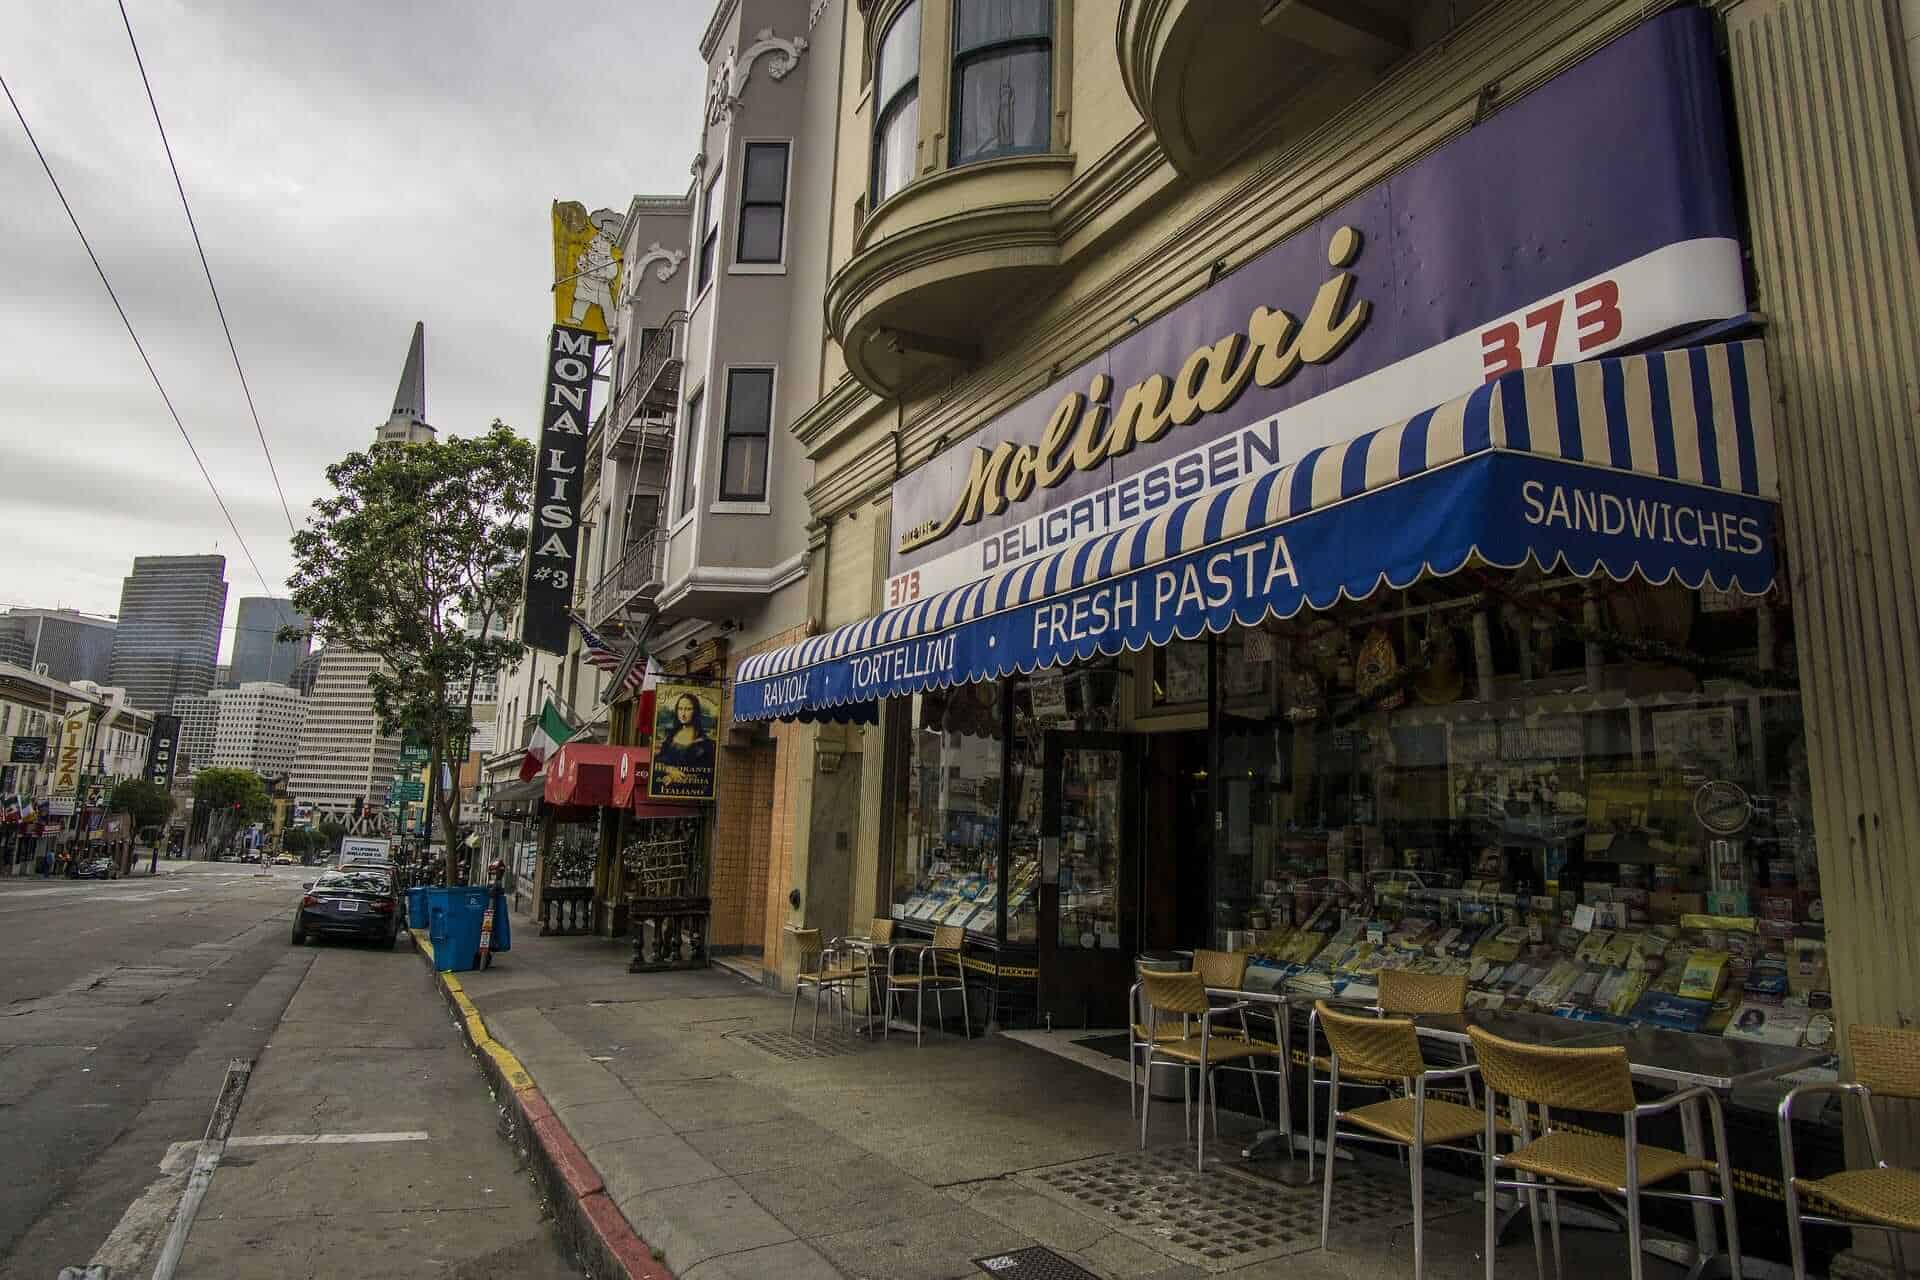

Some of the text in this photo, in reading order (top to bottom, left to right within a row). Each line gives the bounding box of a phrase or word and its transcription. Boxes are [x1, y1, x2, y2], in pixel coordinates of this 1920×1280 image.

[897, 225, 1368, 553] Molinari
[1481, 279, 1622, 384] 373
[533, 330, 592, 590] MONA LISA #3
[981, 420, 1281, 570] DELICATESSEN
[1521, 480, 1763, 555] SANDWICHES
[763, 535, 1299, 706] RAVIOLI TORTELLINI FRESH PASTA
[889, 571, 920, 608] 373
[60, 720, 82, 785] PIZZA
